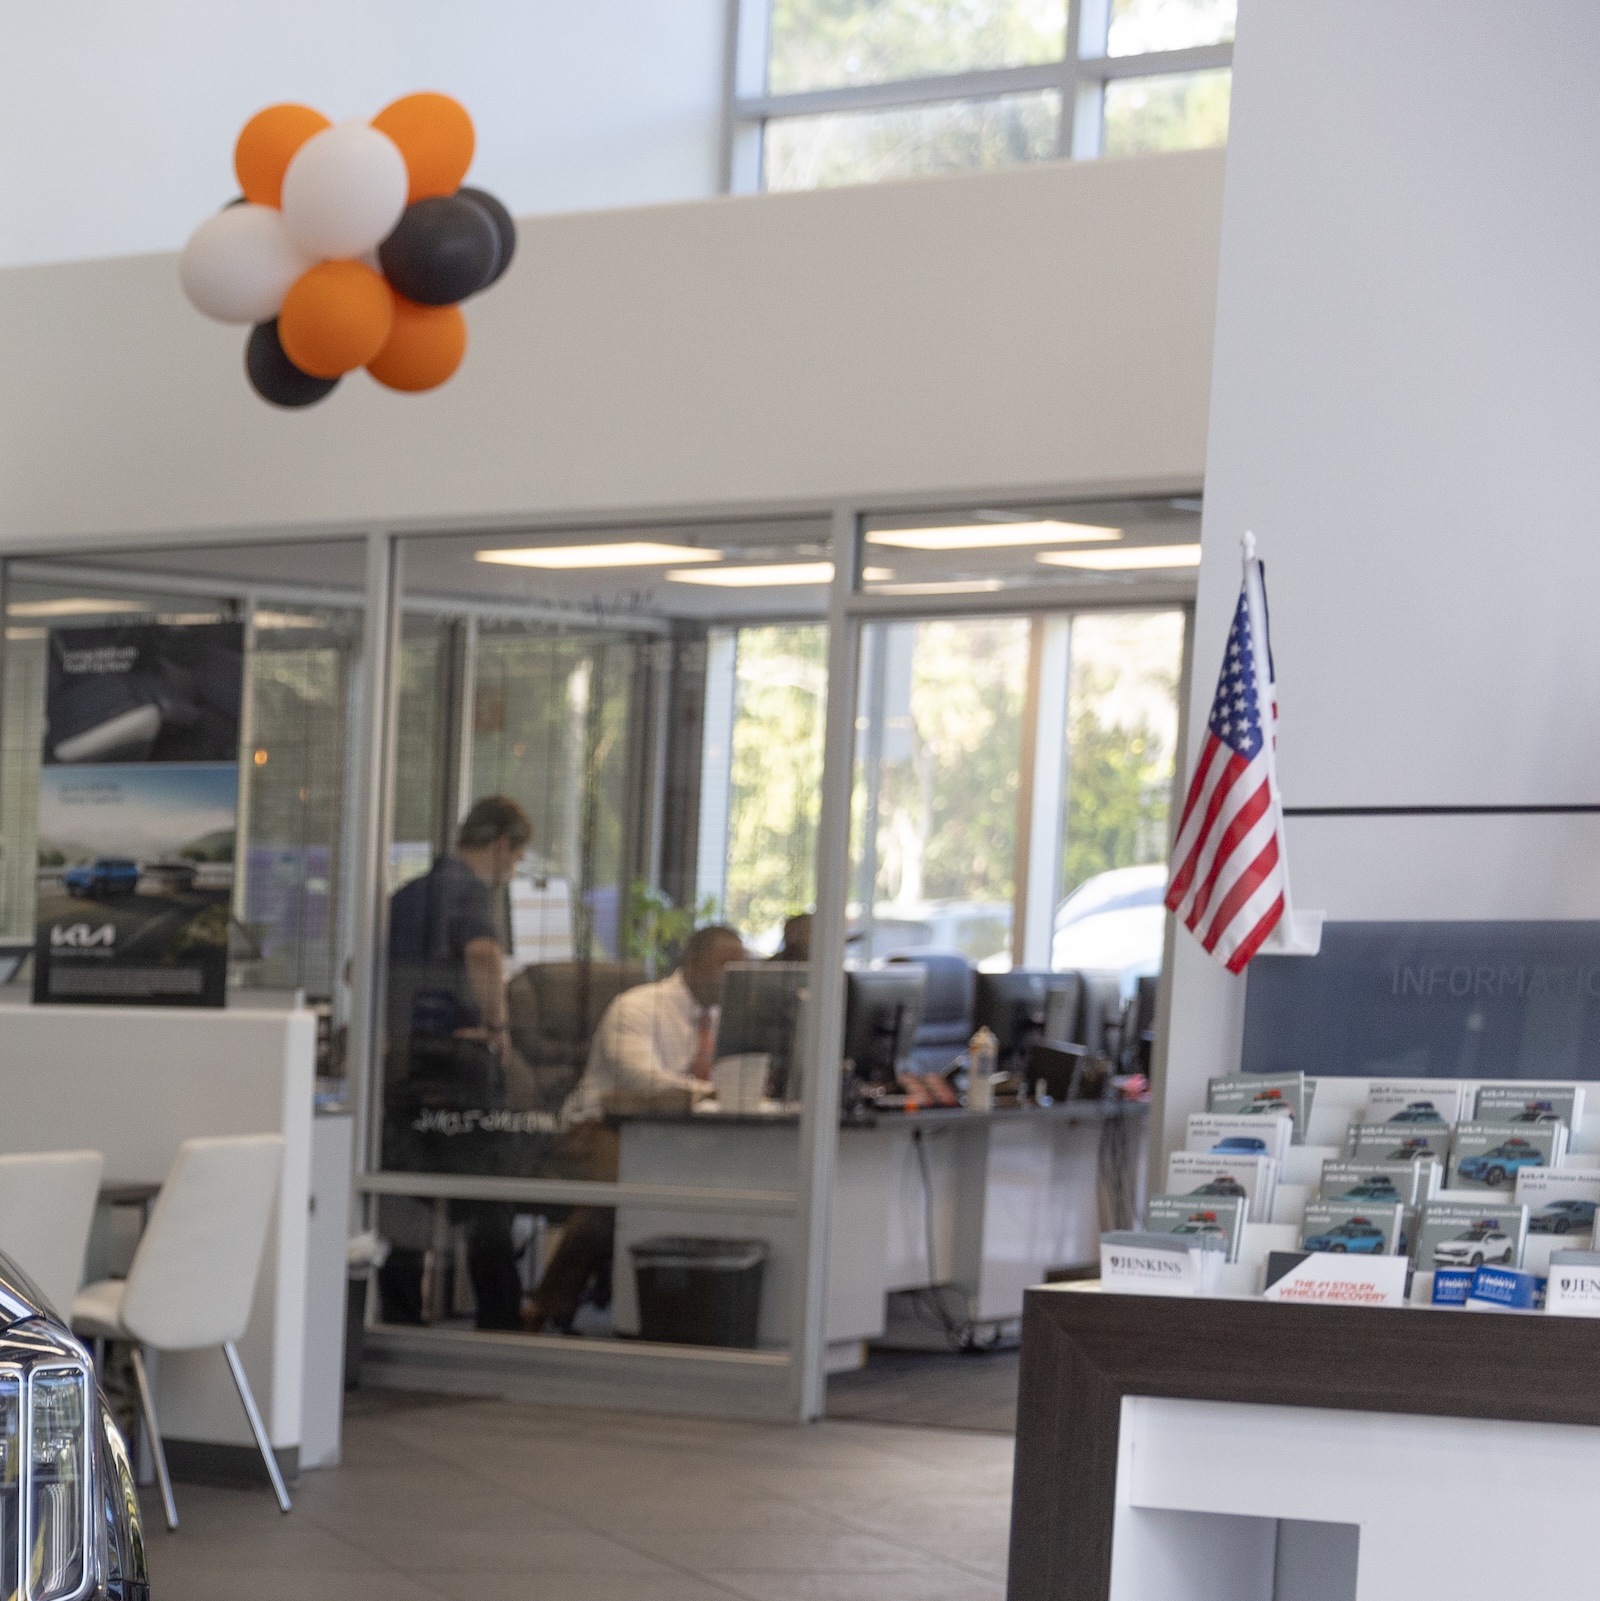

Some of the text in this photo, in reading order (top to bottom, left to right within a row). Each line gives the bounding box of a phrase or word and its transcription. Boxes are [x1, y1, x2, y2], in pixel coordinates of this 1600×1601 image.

[50, 923, 116, 947] KIA
[1120, 1256, 1183, 1273] JENKINS
[1294, 1279, 1315, 1289] THE
[1332, 1281, 1376, 1291] STOLEN
[1280, 1288, 1388, 1302] VEHICLE RECOVERY
